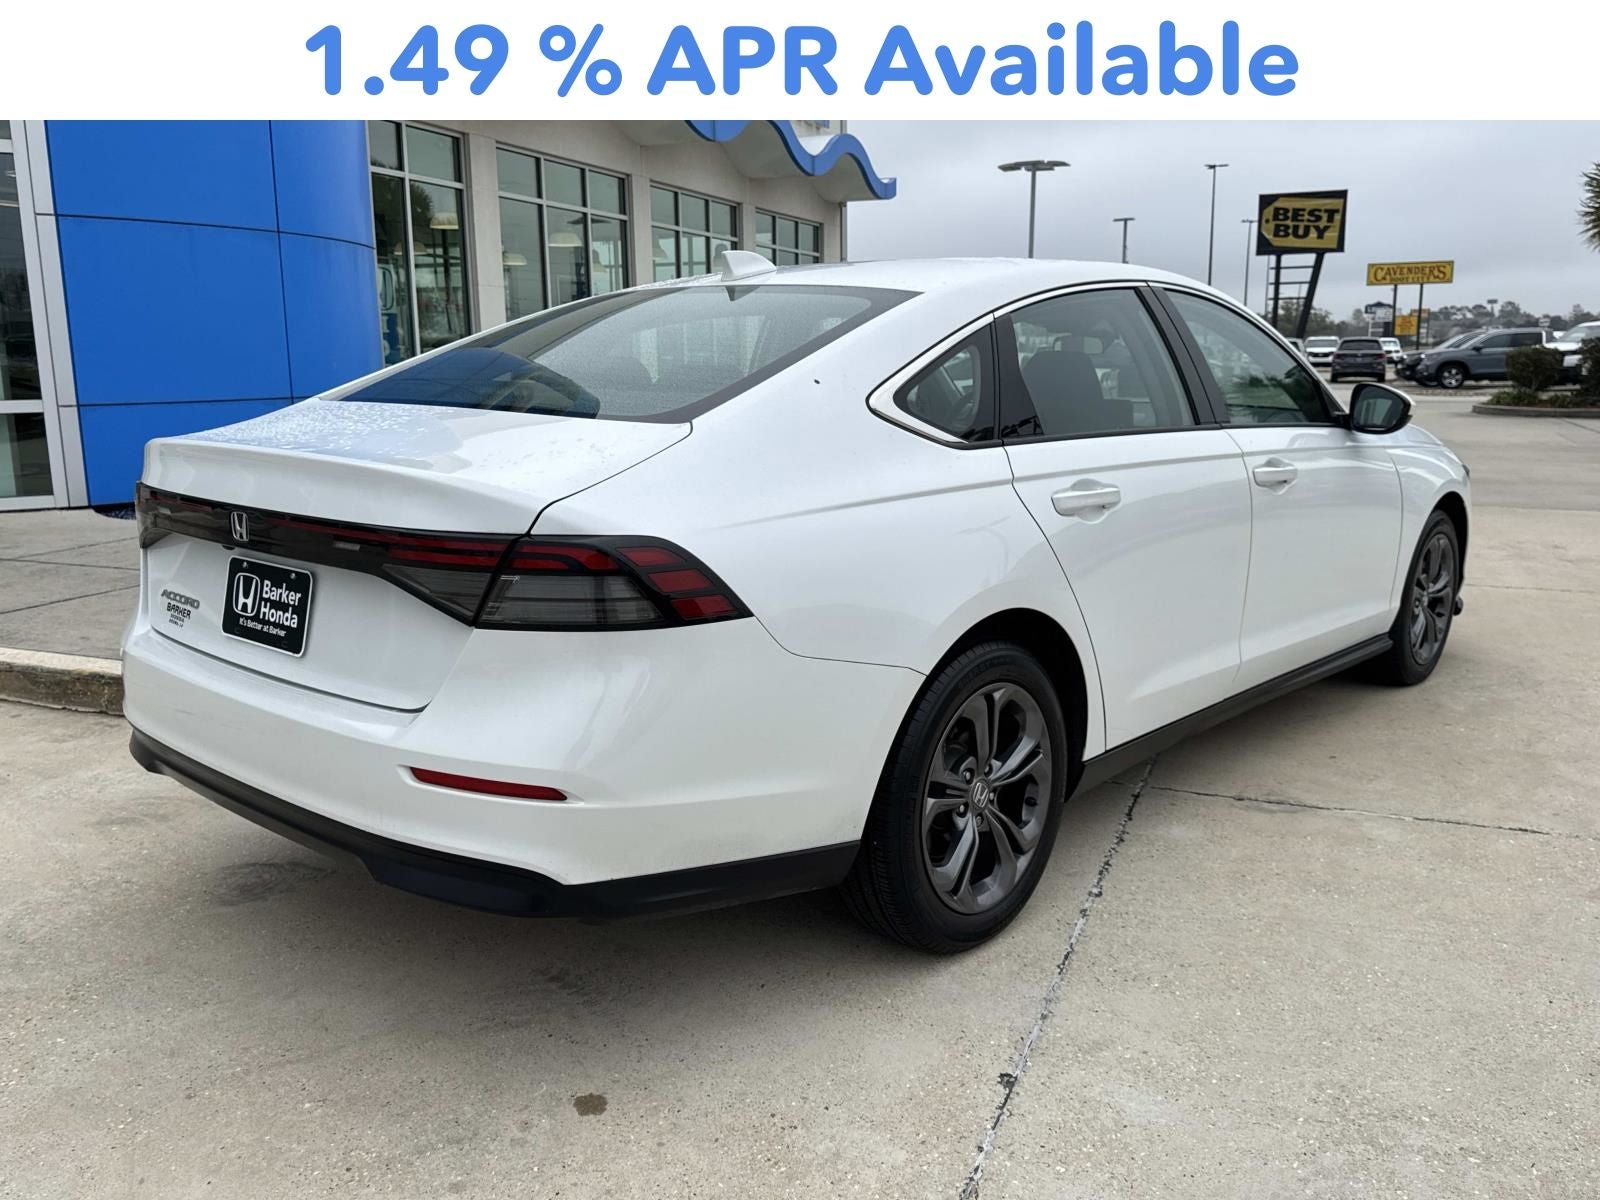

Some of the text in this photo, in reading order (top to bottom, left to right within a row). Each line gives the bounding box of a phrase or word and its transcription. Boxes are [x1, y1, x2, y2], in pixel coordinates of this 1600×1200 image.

[1272, 207, 1340, 224] BEST
[1272, 223, 1332, 240] BUY
[1373, 264, 1447, 282] CAVENDER'S
[160, 588, 200, 609] ACCORD
[262, 579, 301, 606] Barker
[166, 602, 191, 620] BARKER
[259, 600, 298, 628] Honda
[239, 616, 287, 637] It's Better at Barker
